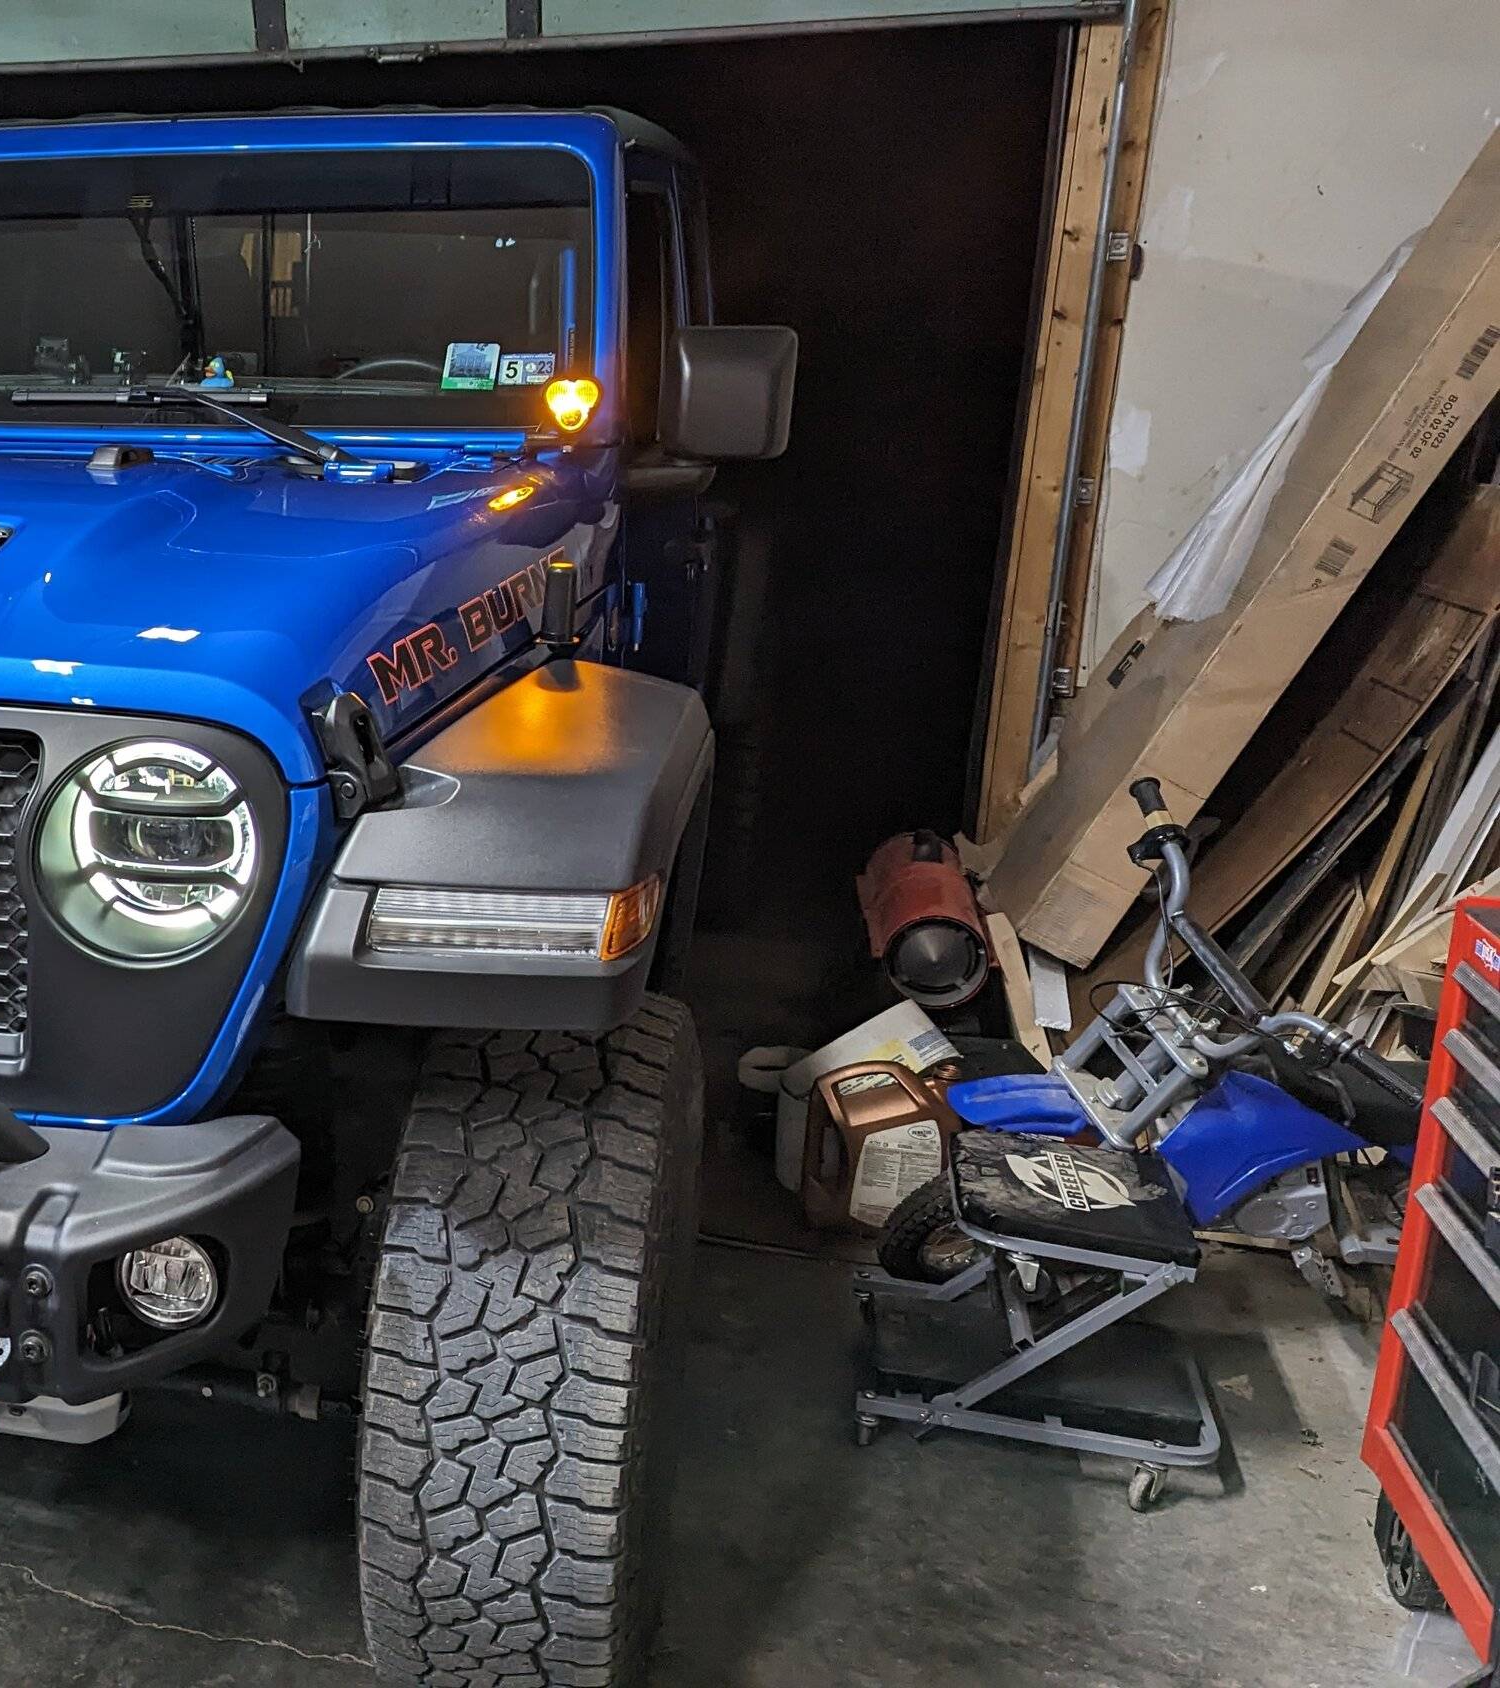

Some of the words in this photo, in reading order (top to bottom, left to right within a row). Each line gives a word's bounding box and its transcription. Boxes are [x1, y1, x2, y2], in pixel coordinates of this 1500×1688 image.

[506, 361, 518, 379] 5
[539, 360, 553, 374] 23
[1440, 394, 1459, 418] BOX
[1430, 418, 1443, 431] 02
[1431, 415, 1460, 449] TR1023
[1421, 431, 1433, 447] OF
[1410, 446, 1423, 459] 02
[366, 622, 459, 706] MR.
[457, 546, 565, 653] BURN
[1053, 1154, 1086, 1209] CREEPER
